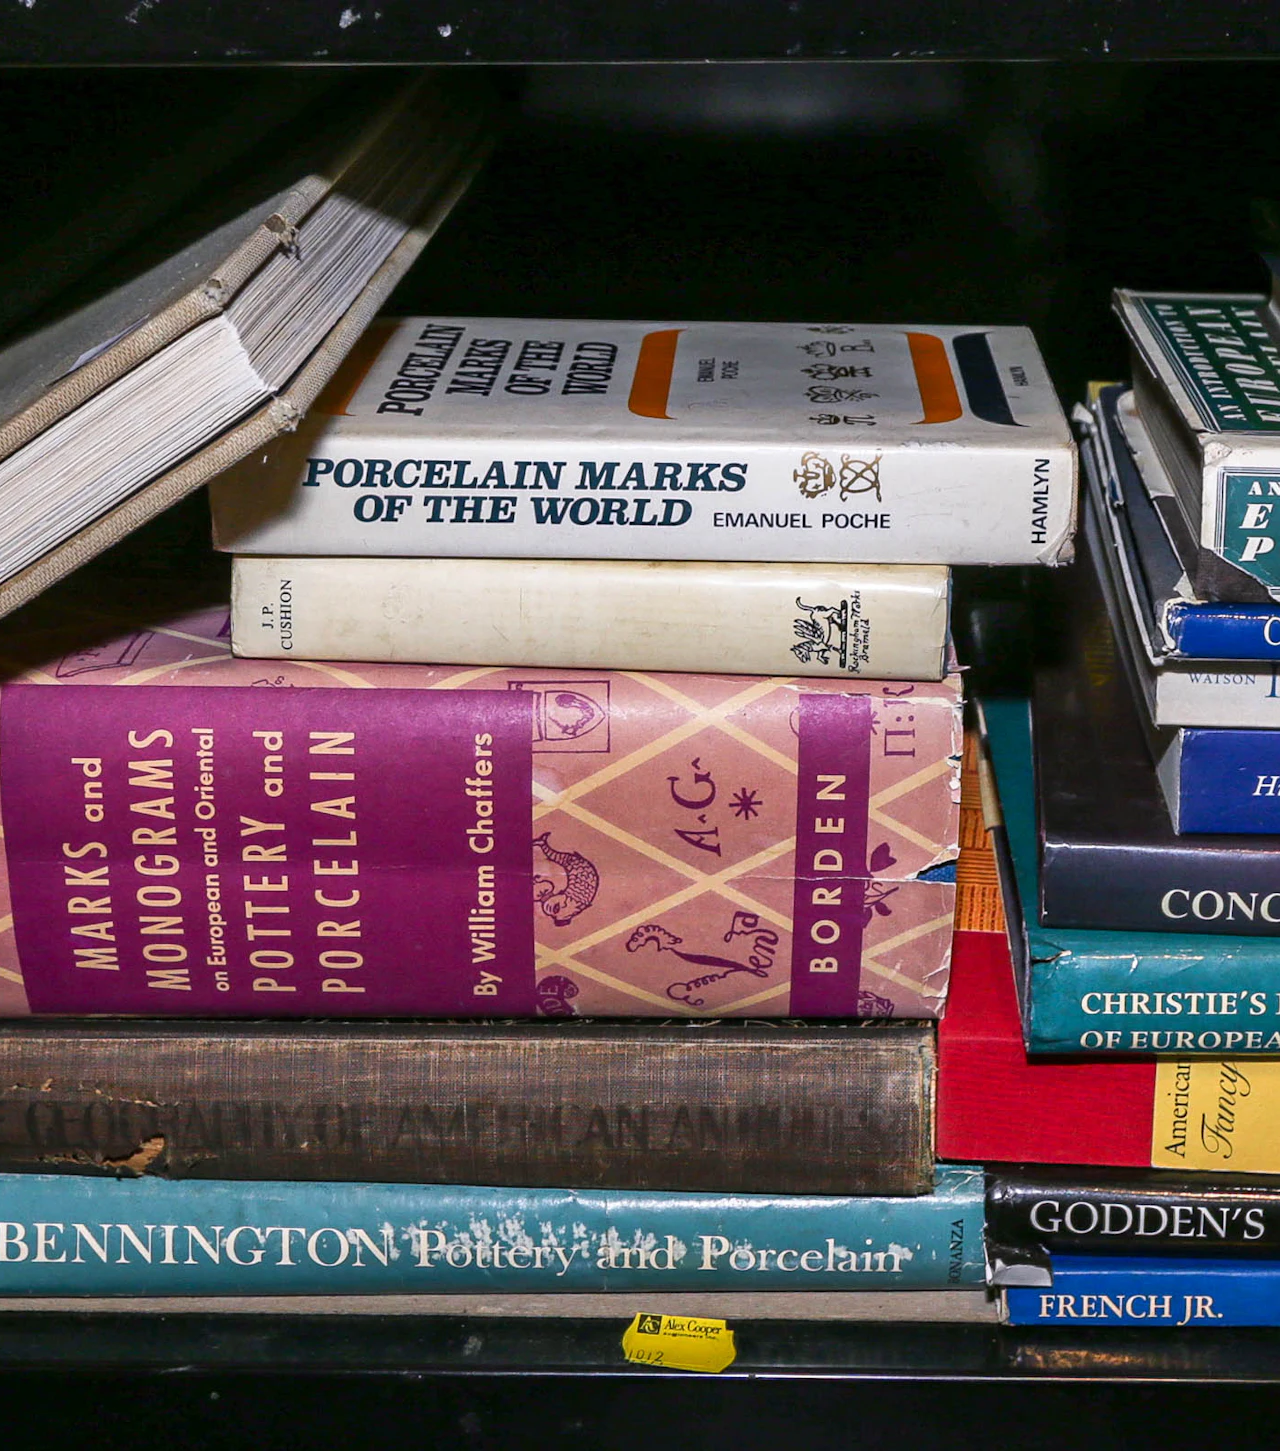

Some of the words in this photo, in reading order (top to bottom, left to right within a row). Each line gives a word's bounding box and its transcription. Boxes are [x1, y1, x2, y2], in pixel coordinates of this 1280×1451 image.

[376, 324, 466, 416] PORCELAIN
[445, 338, 512, 396] MARKS
[514, 340, 565, 371] THE
[561, 341, 618, 395] WORLD
[697, 357, 716, 383] EMANUEL
[721, 360, 739, 380] POCHE
[504, 373, 552, 396] OF
[302, 458, 567, 490] PORCELAIN
[574, 461, 748, 492] MARKS
[1031, 458, 1050, 544] HAMLYN
[353, 494, 413, 523] OF
[423, 495, 517, 523] THE
[530, 496, 694, 526] WORLD
[713, 512, 812, 528] EMANUEL
[822, 513, 891, 529] POCHE
[281, 579, 293, 650] CUSHION
[1189, 673, 1256, 685] WATSON
[72, 758, 104, 823] and
[191, 728, 216, 820] Oriental
[253, 731, 283, 797] and
[465, 733, 494, 853] Chaffers
[128, 729, 192, 991] MONOGRAMS
[194, 827, 218, 868] and
[310, 731, 366, 992] PORCELAIN
[809, 774, 846, 972] BORDEN
[63, 841, 119, 972] MARKS
[205, 874, 227, 966] European
[239, 817, 296, 992] POTTERY
[470, 865, 498, 967] William
[215, 971, 230, 992] on
[474, 973, 502, 997] By
[1080, 991, 1267, 1016] CHRISTIE'S
[1079, 1030, 1121, 1049] OF
[1165, 1057, 1191, 1158] American
[1201, 1060, 1250, 1159] Fancy
[1029, 1200, 1265, 1240] GODDEN'S
[413, 1228, 580, 1278] Pottery
[596, 1234, 677, 1274] and
[697, 1236, 903, 1275] Porcelain
[664, 1319, 685, 1331] Alex
[688, 1320, 722, 1336] Cooper
[1038, 1295, 1172, 1318] FRENCH
[1178, 1296, 1223, 1324] JR.
